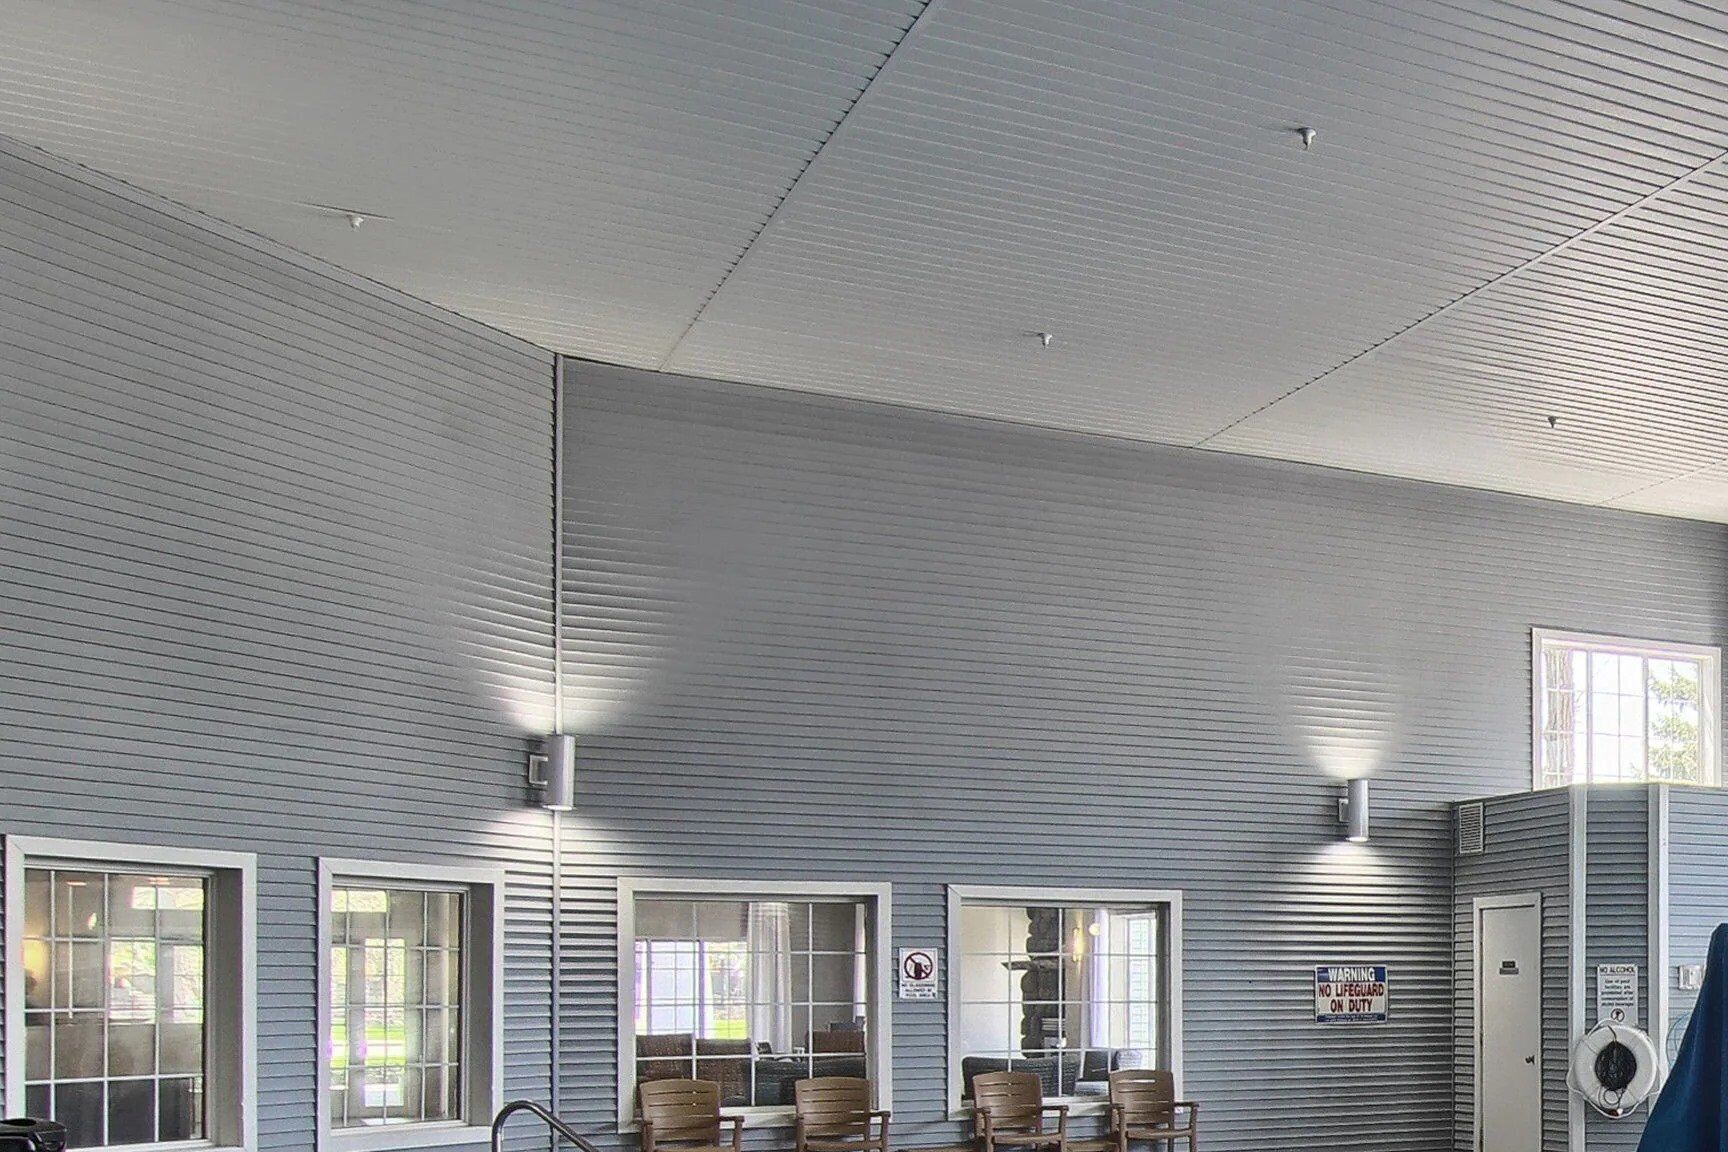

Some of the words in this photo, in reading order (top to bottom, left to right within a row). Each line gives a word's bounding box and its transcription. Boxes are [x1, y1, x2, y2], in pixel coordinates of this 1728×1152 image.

[1328, 967, 1375, 982] WARNING
[1319, 984, 1331, 997] NO
[1336, 984, 1384, 997] LIFEGUARD
[1330, 998, 1343, 1012] ON
[1349, 998, 1372, 1012] DUTY
